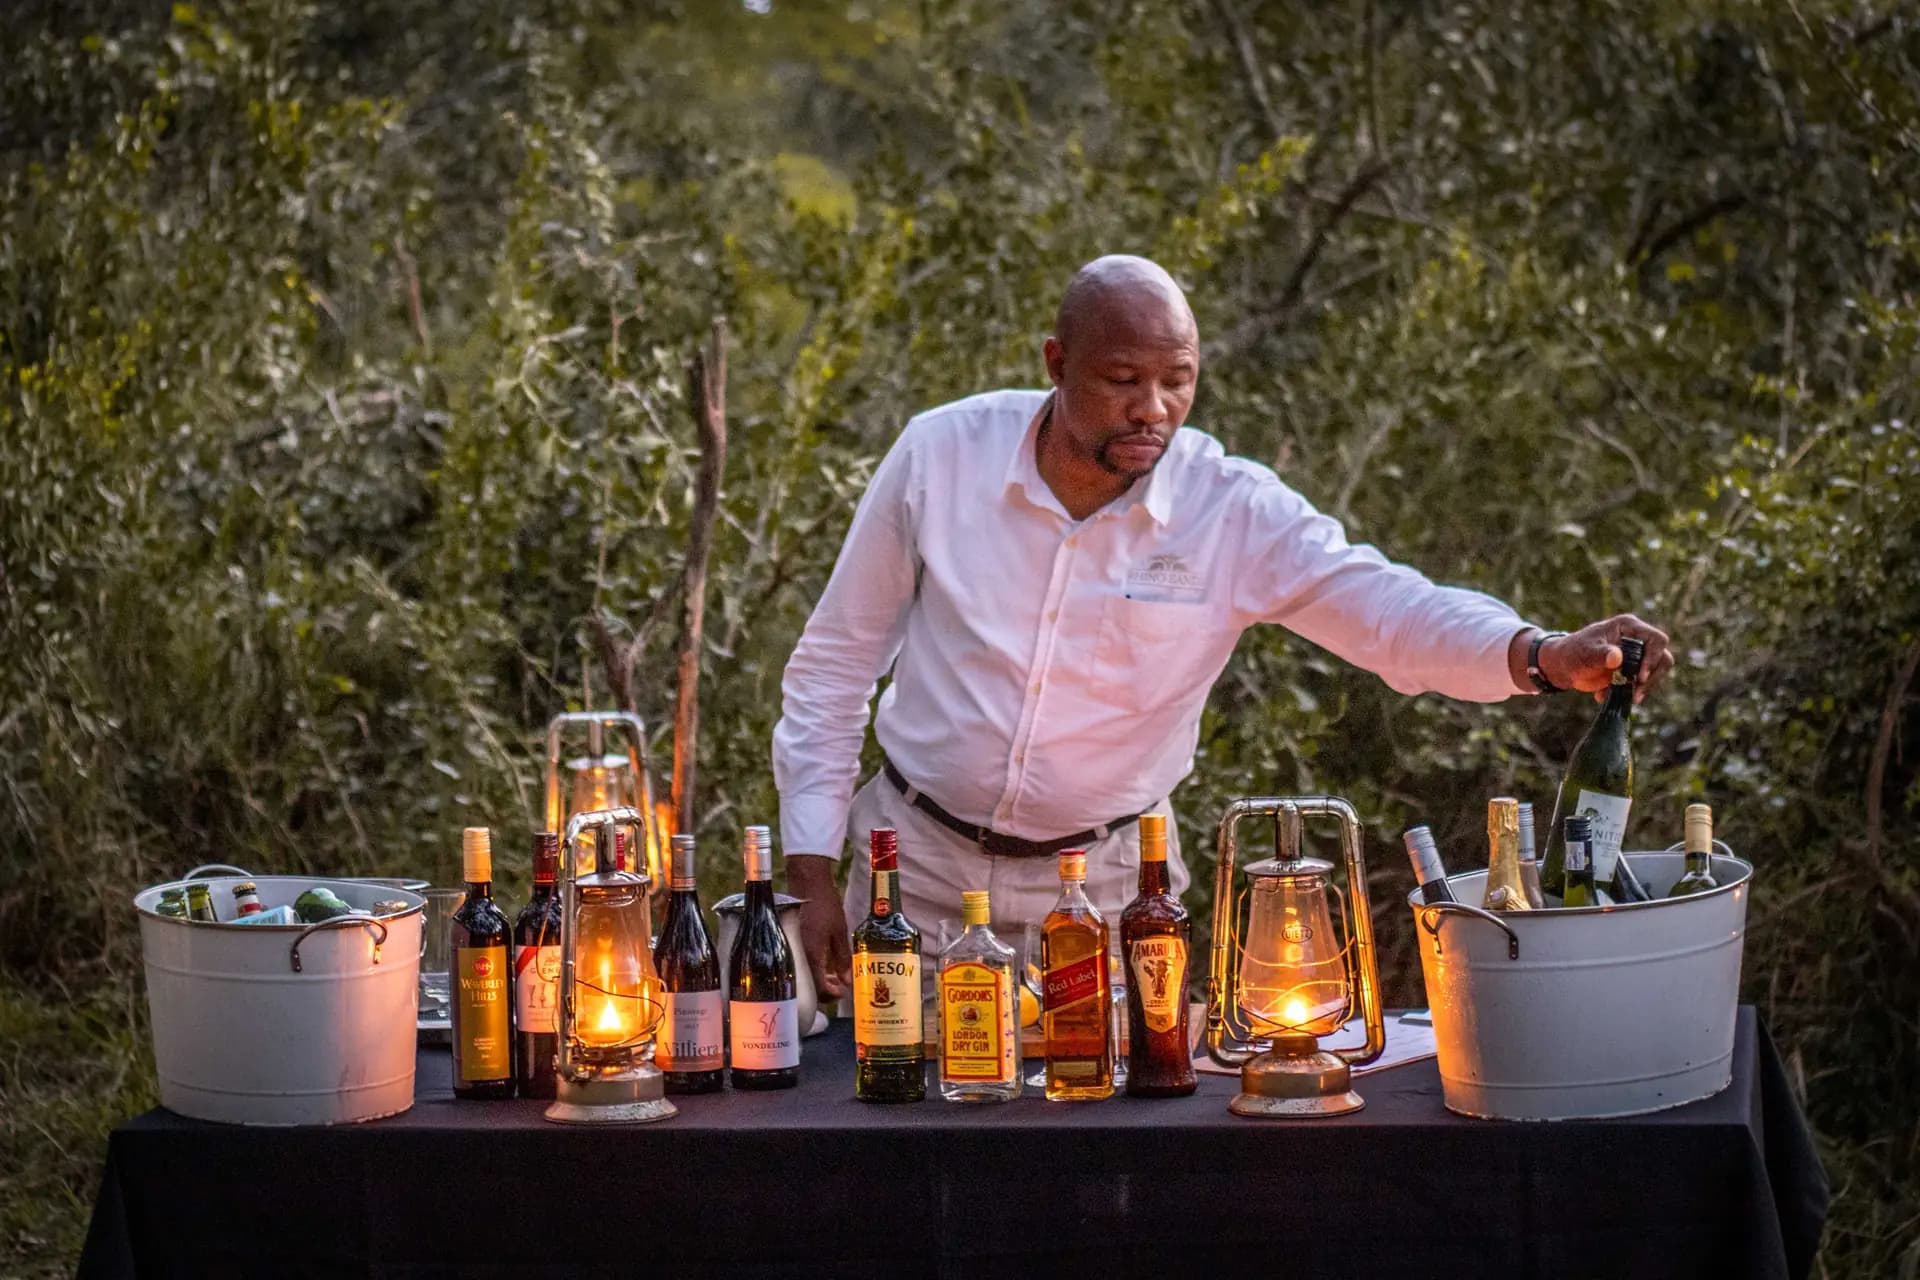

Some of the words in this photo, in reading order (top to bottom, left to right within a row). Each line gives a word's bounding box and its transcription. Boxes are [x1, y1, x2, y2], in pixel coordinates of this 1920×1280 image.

[854, 961, 915, 979] JAMESON
[1047, 978, 1069, 994] Red
[1069, 968, 1096, 986] Label
[952, 1030, 989, 1041] LONDON
[662, 1039, 720, 1058] Villiera
[952, 1041, 972, 1052] DRY
[972, 1041, 990, 1053] GIN
